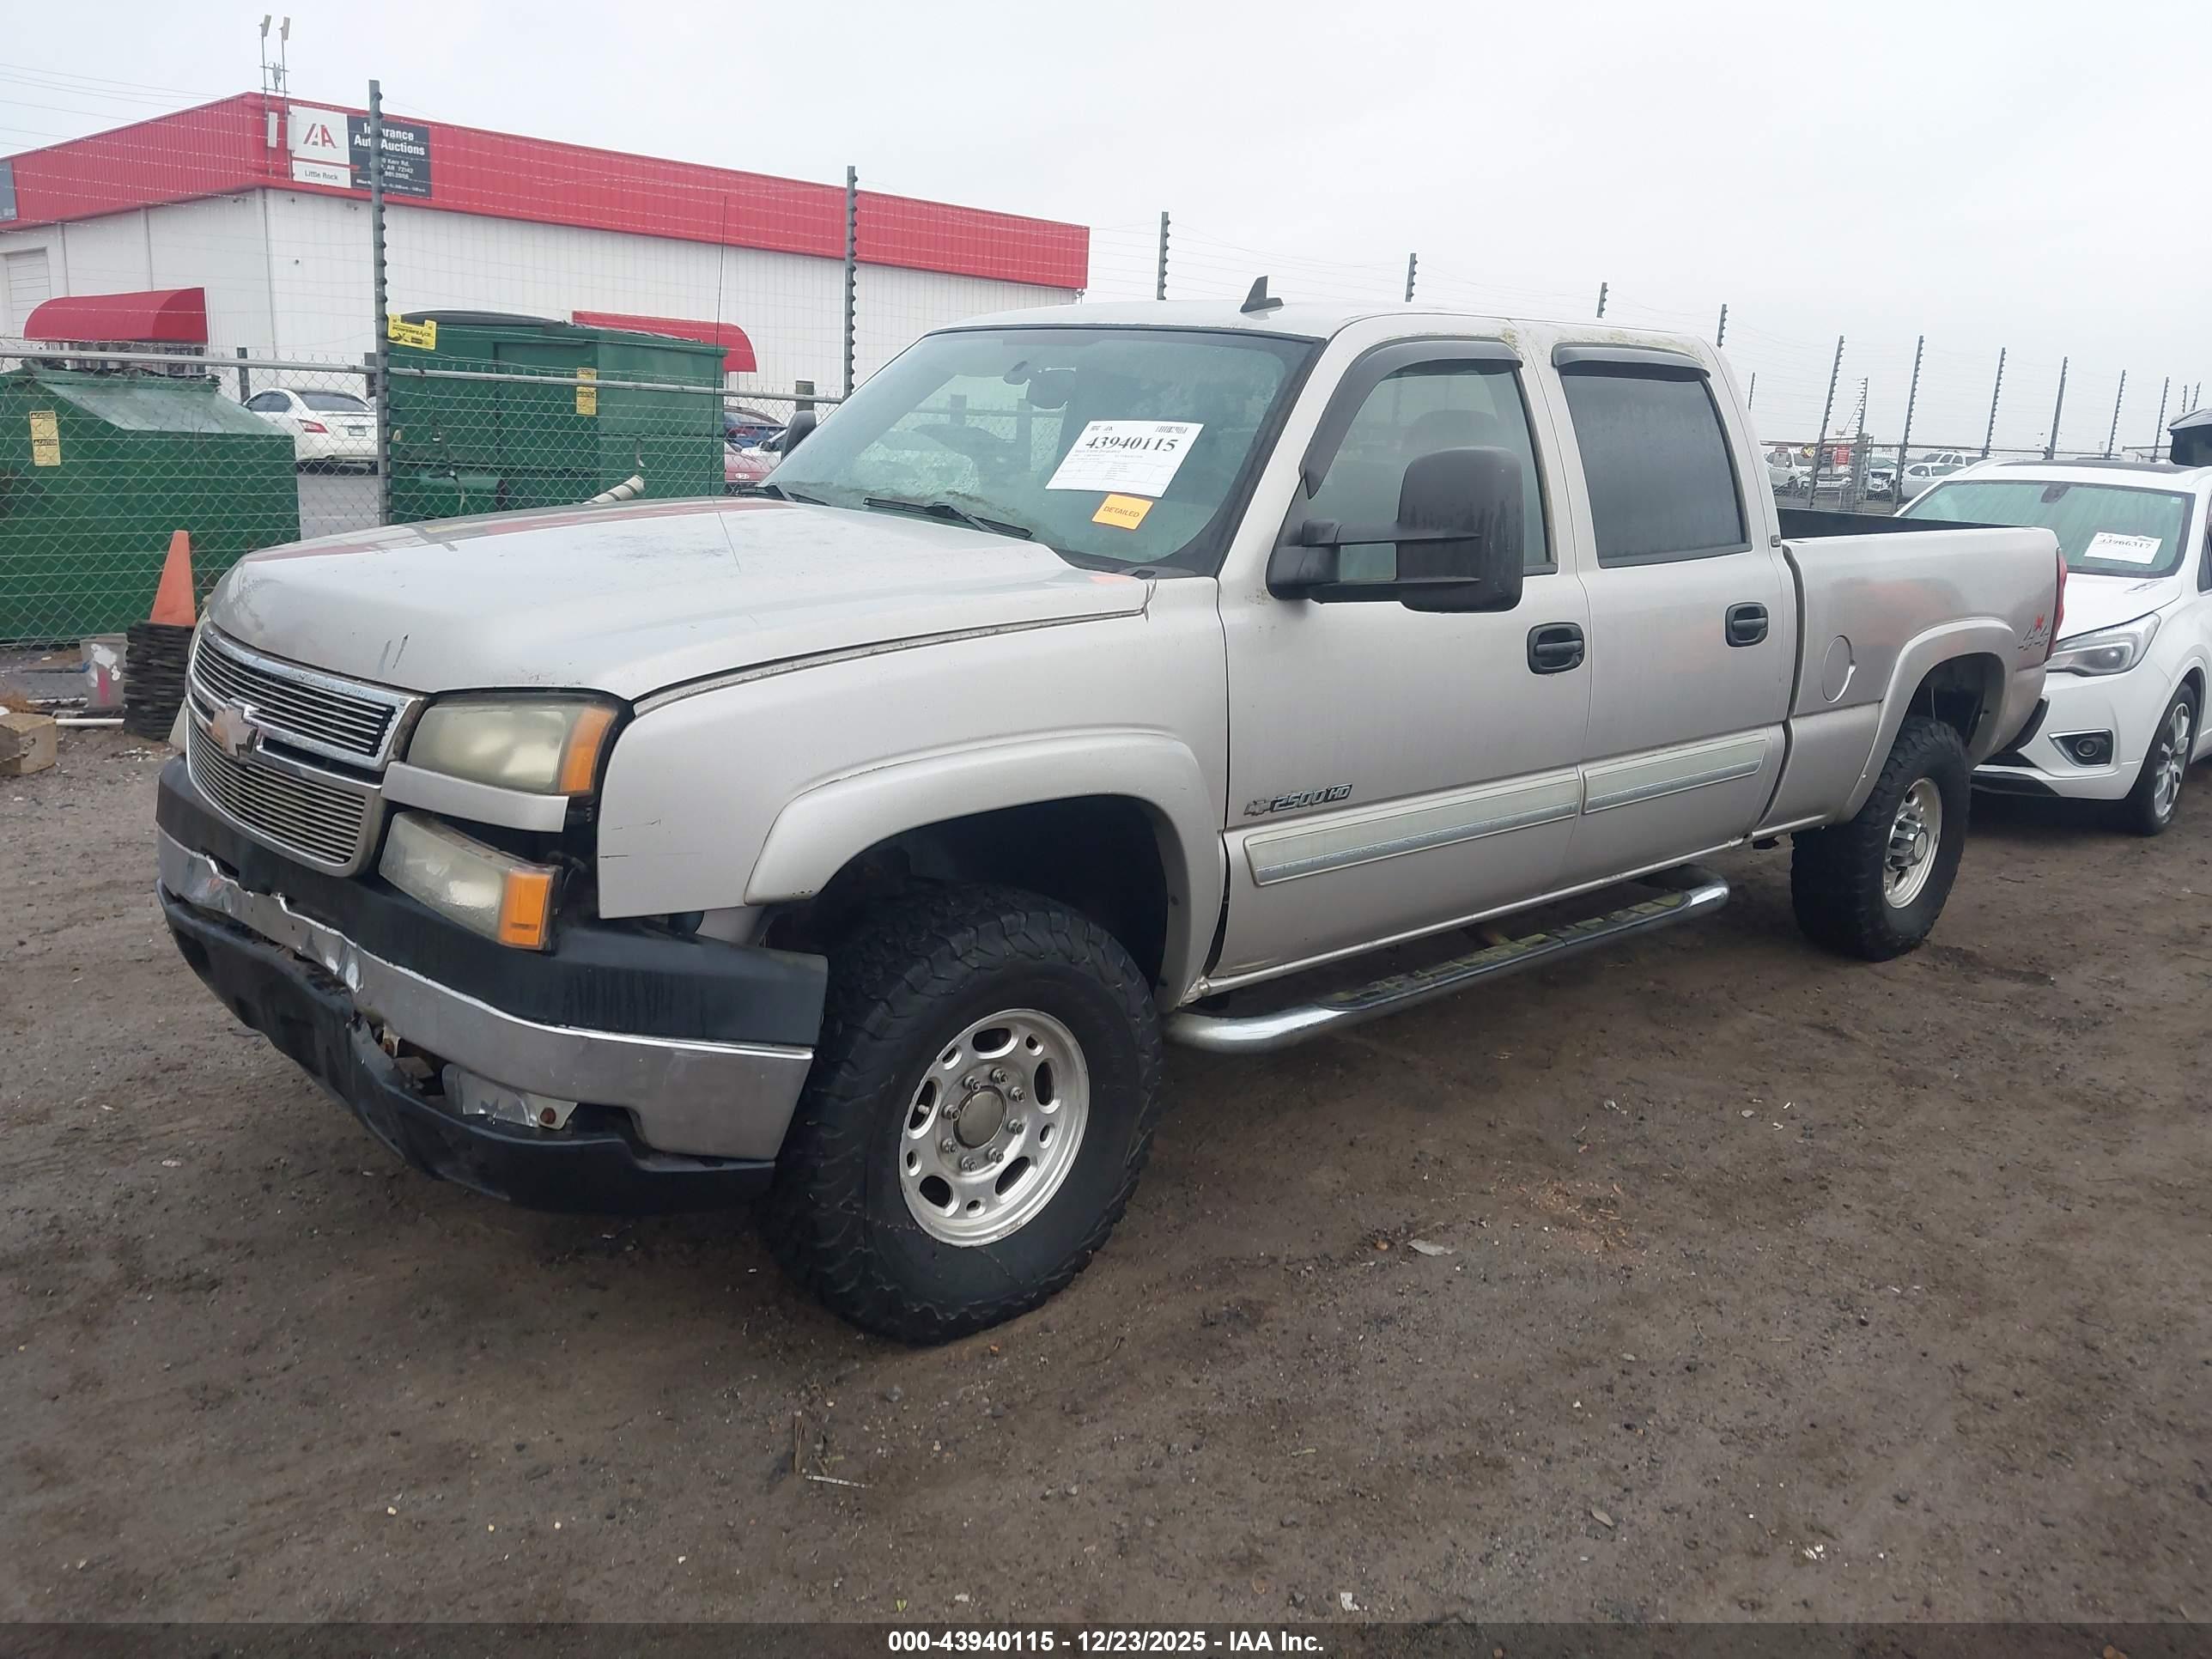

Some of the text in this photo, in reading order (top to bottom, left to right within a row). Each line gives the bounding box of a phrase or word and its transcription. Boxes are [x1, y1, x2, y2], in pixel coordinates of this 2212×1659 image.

[363, 122, 414, 141] Irance
[354, 134, 425, 155] Aut Auctions
[304, 169, 338, 180] Little Rock
[1085, 435, 1180, 453] 43940115
[1103, 506, 1140, 518] DETAILED
